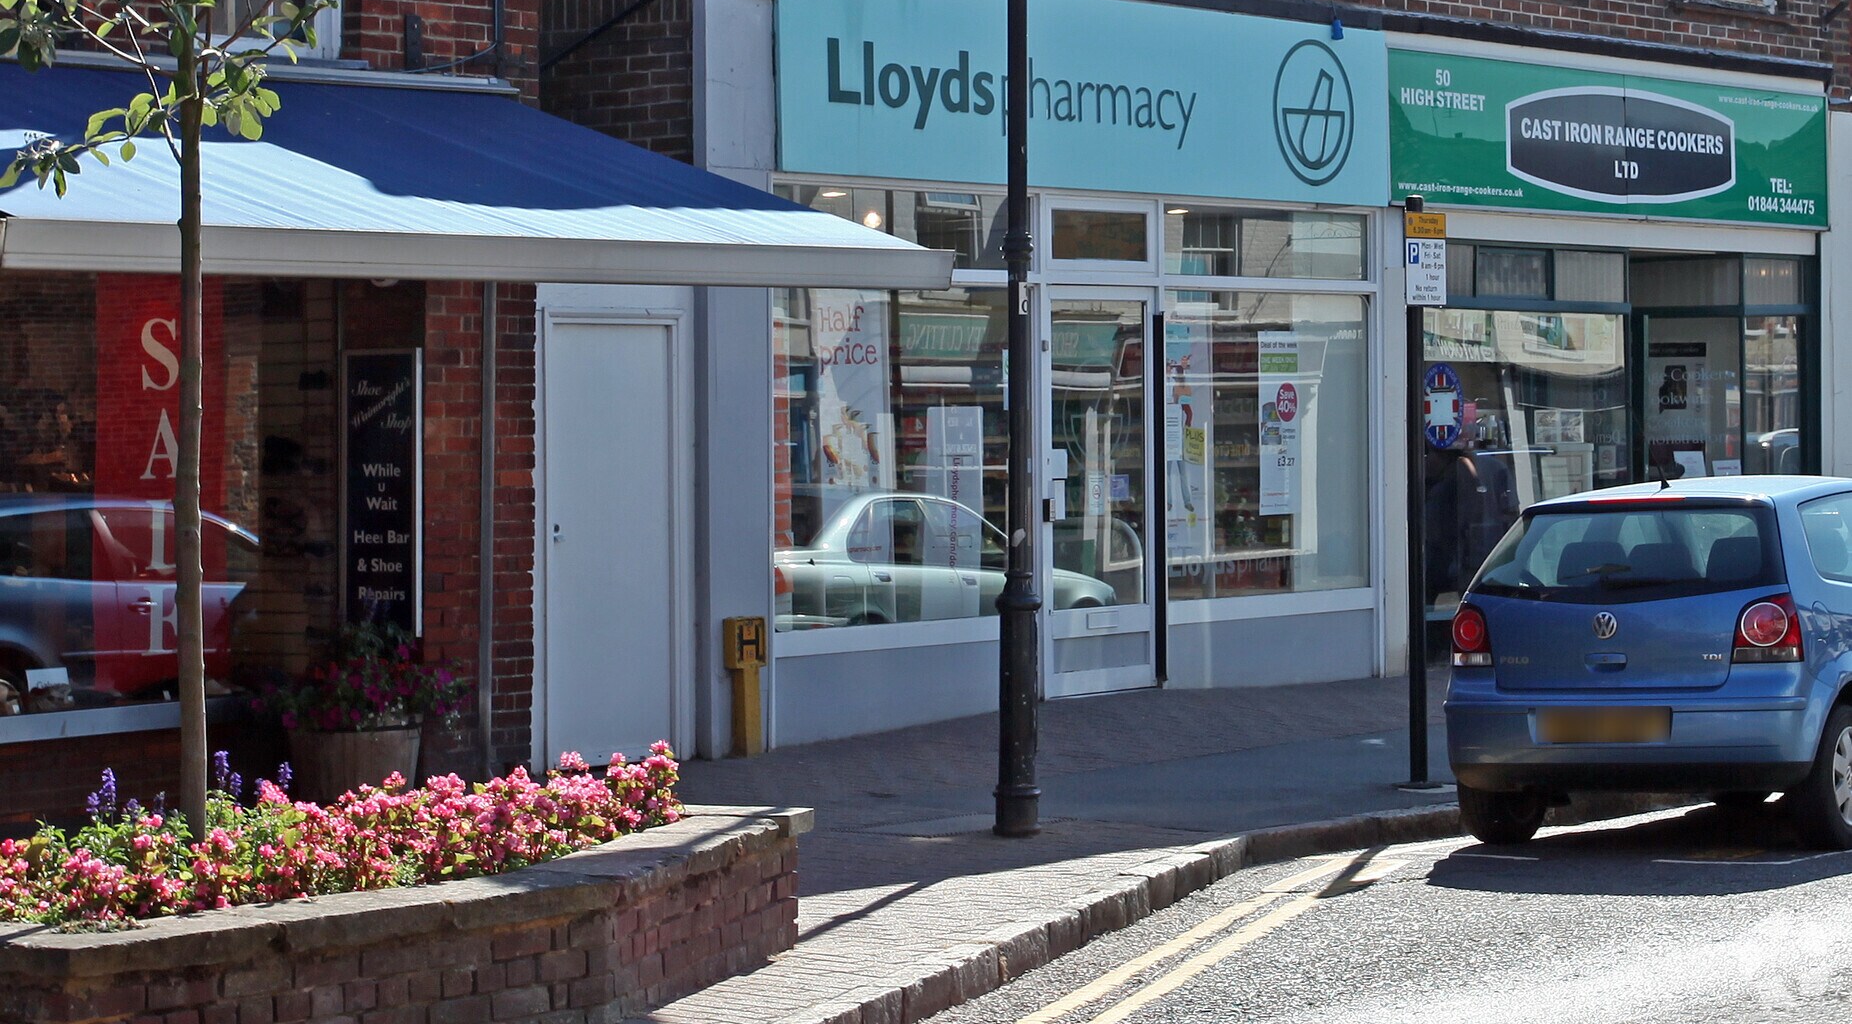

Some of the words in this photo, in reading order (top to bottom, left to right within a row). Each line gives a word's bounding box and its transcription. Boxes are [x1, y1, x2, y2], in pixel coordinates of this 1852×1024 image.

[1435, 69, 1451, 87] 50
[1400, 87, 1434, 107] HIGH
[1436, 91, 1486, 112] STREET
[1718, 94, 1819, 113] www.cast-iron-range-cookers.co.uk
[1520, 117, 1562, 141] CAST
[1564, 121, 1602, 145] IRON
[1604, 124, 1656, 150] RANGE
[1657, 130, 1724, 155] COOKERS
[1614, 160, 1639, 180] LTD
[1398, 181, 1524, 198] www.cast-iron-range-cookers.co.uk
[1769, 177, 1793, 195] TEL:
[1747, 195, 1778, 213] 01844
[1779, 198, 1816, 215] 344475
[1410, 244, 1418, 263] P
[1415, 284, 1423, 292] No
[818, 305, 865, 333] Half
[818, 337, 878, 376] price
[1280, 389, 1295, 400] Save
[1278, 400, 1296, 413] 40%
[362, 463, 401, 477] While
[1277, 456, 1295, 467] £3.27
[366, 496, 398, 511] Wait
[387, 529, 410, 544] Bar
[357, 558, 368, 573] &
[371, 557, 403, 573] Shoe
[358, 586, 406, 601] Repairs
[739, 623, 760, 662] H
[1499, 655, 1531, 665] POLO
[1701, 653, 1723, 661] TDI
